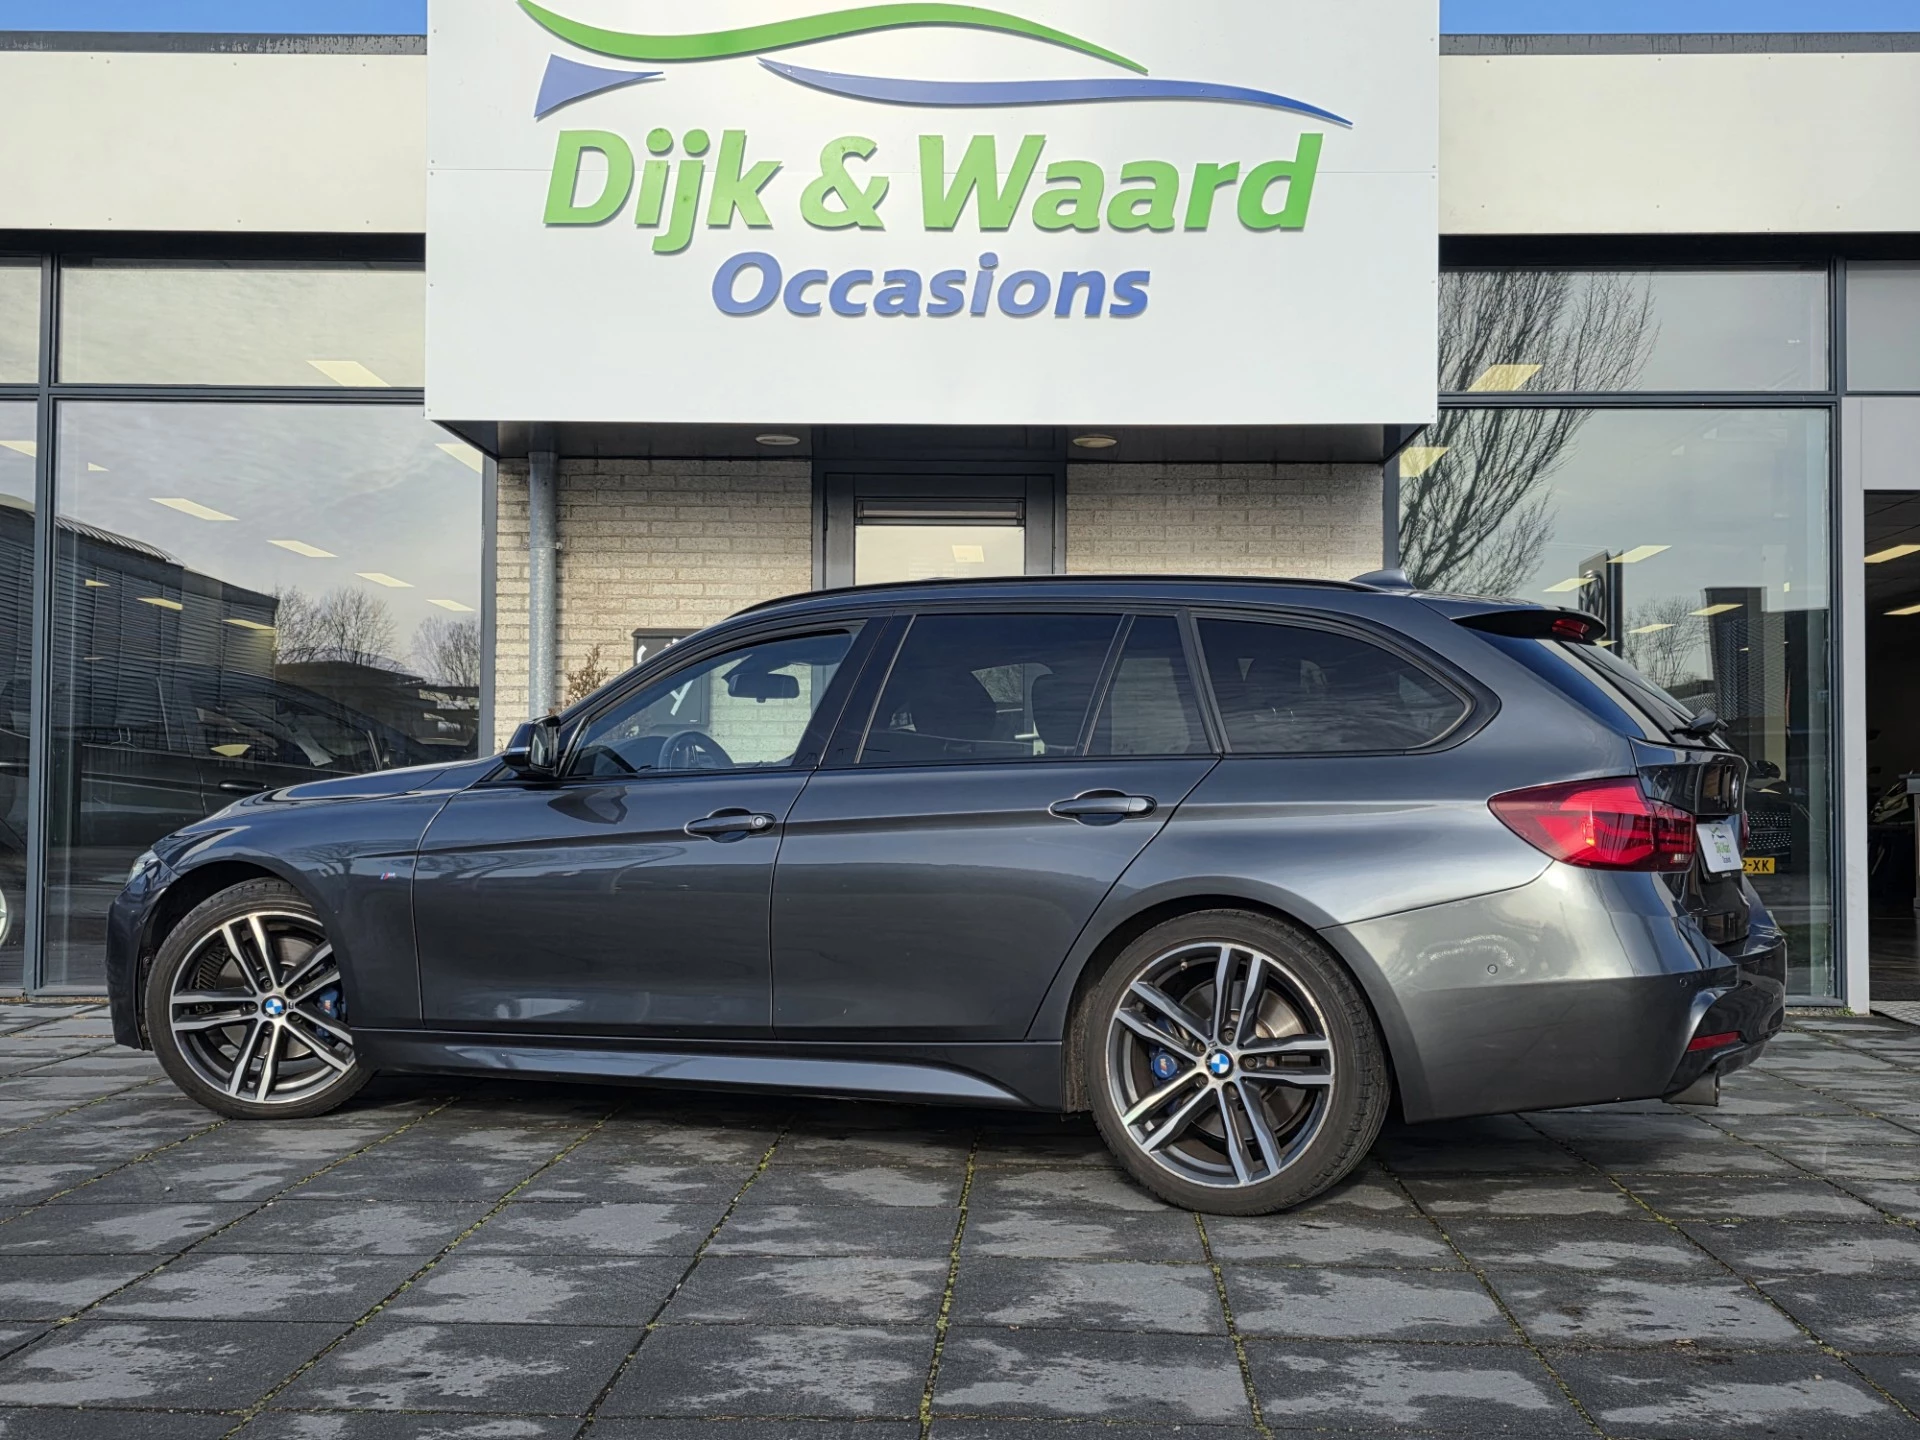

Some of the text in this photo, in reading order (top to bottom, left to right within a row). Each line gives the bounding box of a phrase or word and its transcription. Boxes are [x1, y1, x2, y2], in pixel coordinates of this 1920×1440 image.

[543, 128, 1324, 254] Dijk & Waard
[712, 252, 1150, 316] Occasions
